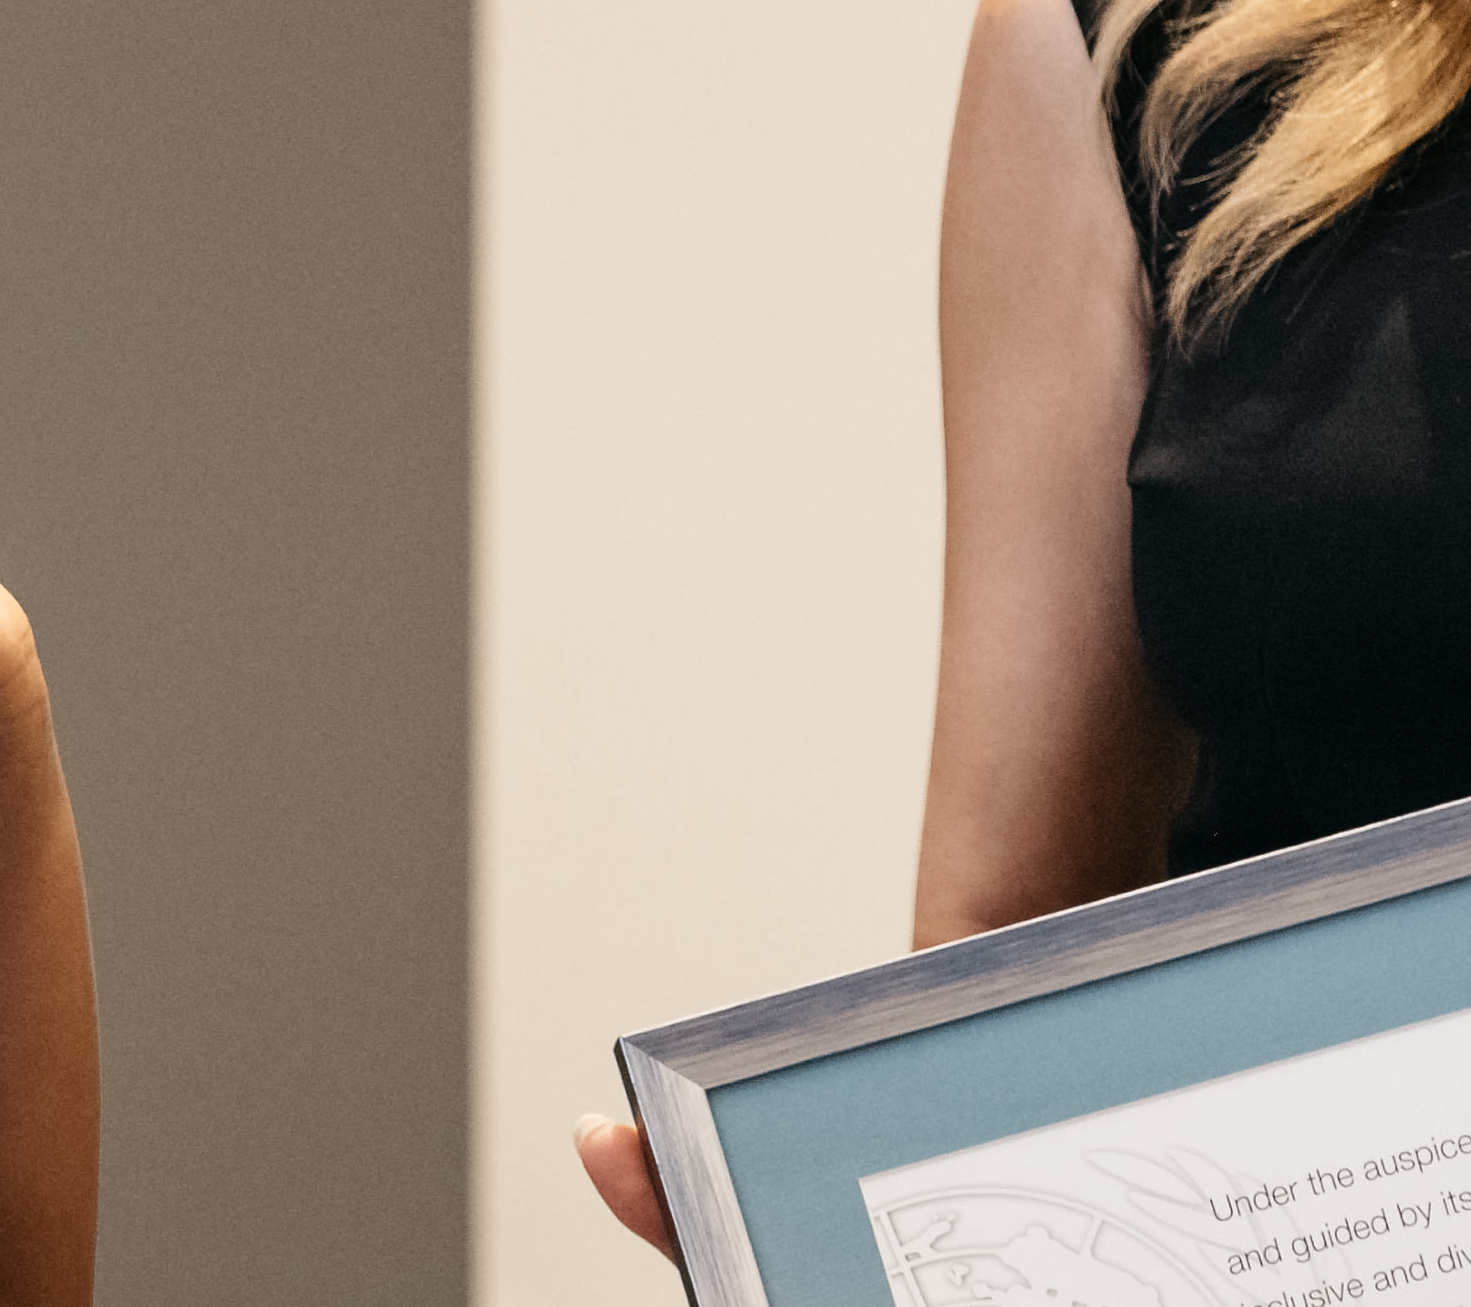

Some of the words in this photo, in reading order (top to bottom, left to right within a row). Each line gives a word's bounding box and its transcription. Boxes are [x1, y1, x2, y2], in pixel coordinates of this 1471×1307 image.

[1209, 1181, 1298, 1222] Under
[1307, 1168, 1355, 1196] the
[1227, 1237, 1283, 1275] and
[1291, 1208, 1390, 1263] guided
[1396, 1202, 1432, 1229] by
[1373, 1253, 1428, 1292] and
